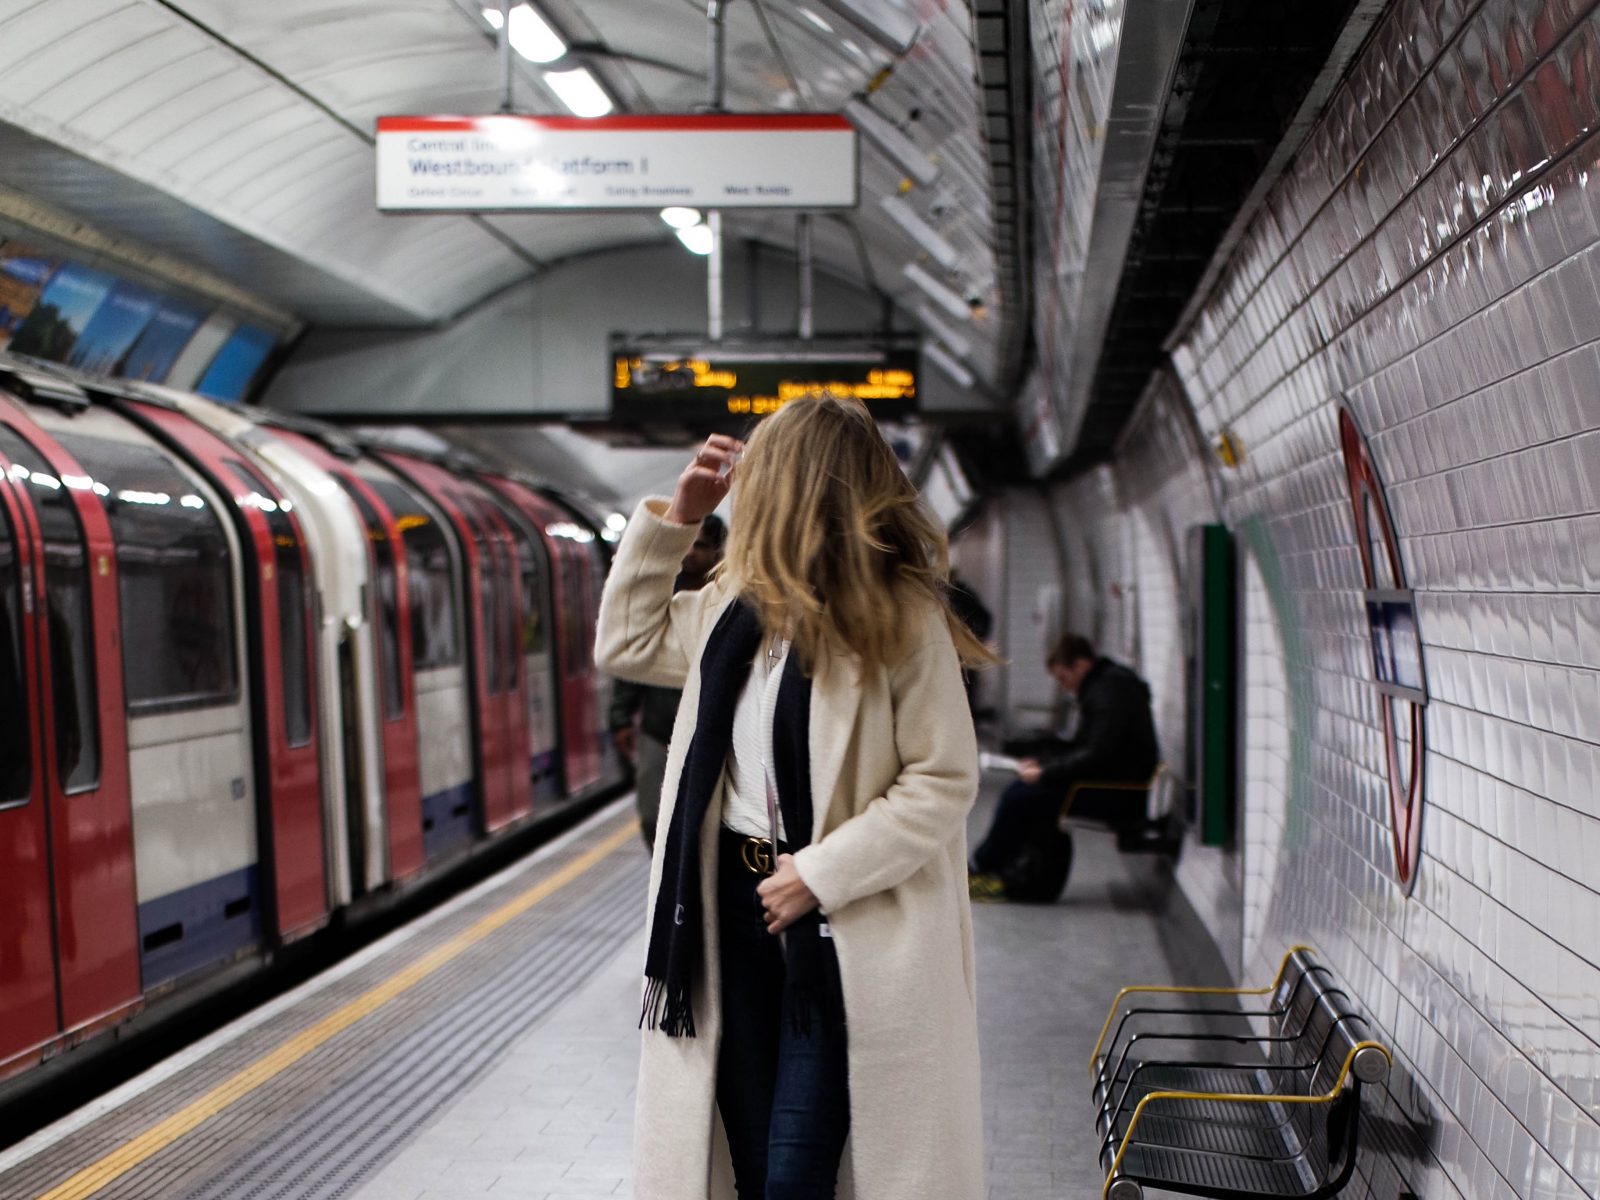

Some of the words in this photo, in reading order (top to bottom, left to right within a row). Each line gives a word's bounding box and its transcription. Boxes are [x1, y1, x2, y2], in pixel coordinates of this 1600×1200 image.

[408, 138, 465, 152] Central
[471, 138, 498, 152] lin
[545, 156, 635, 175] atform
